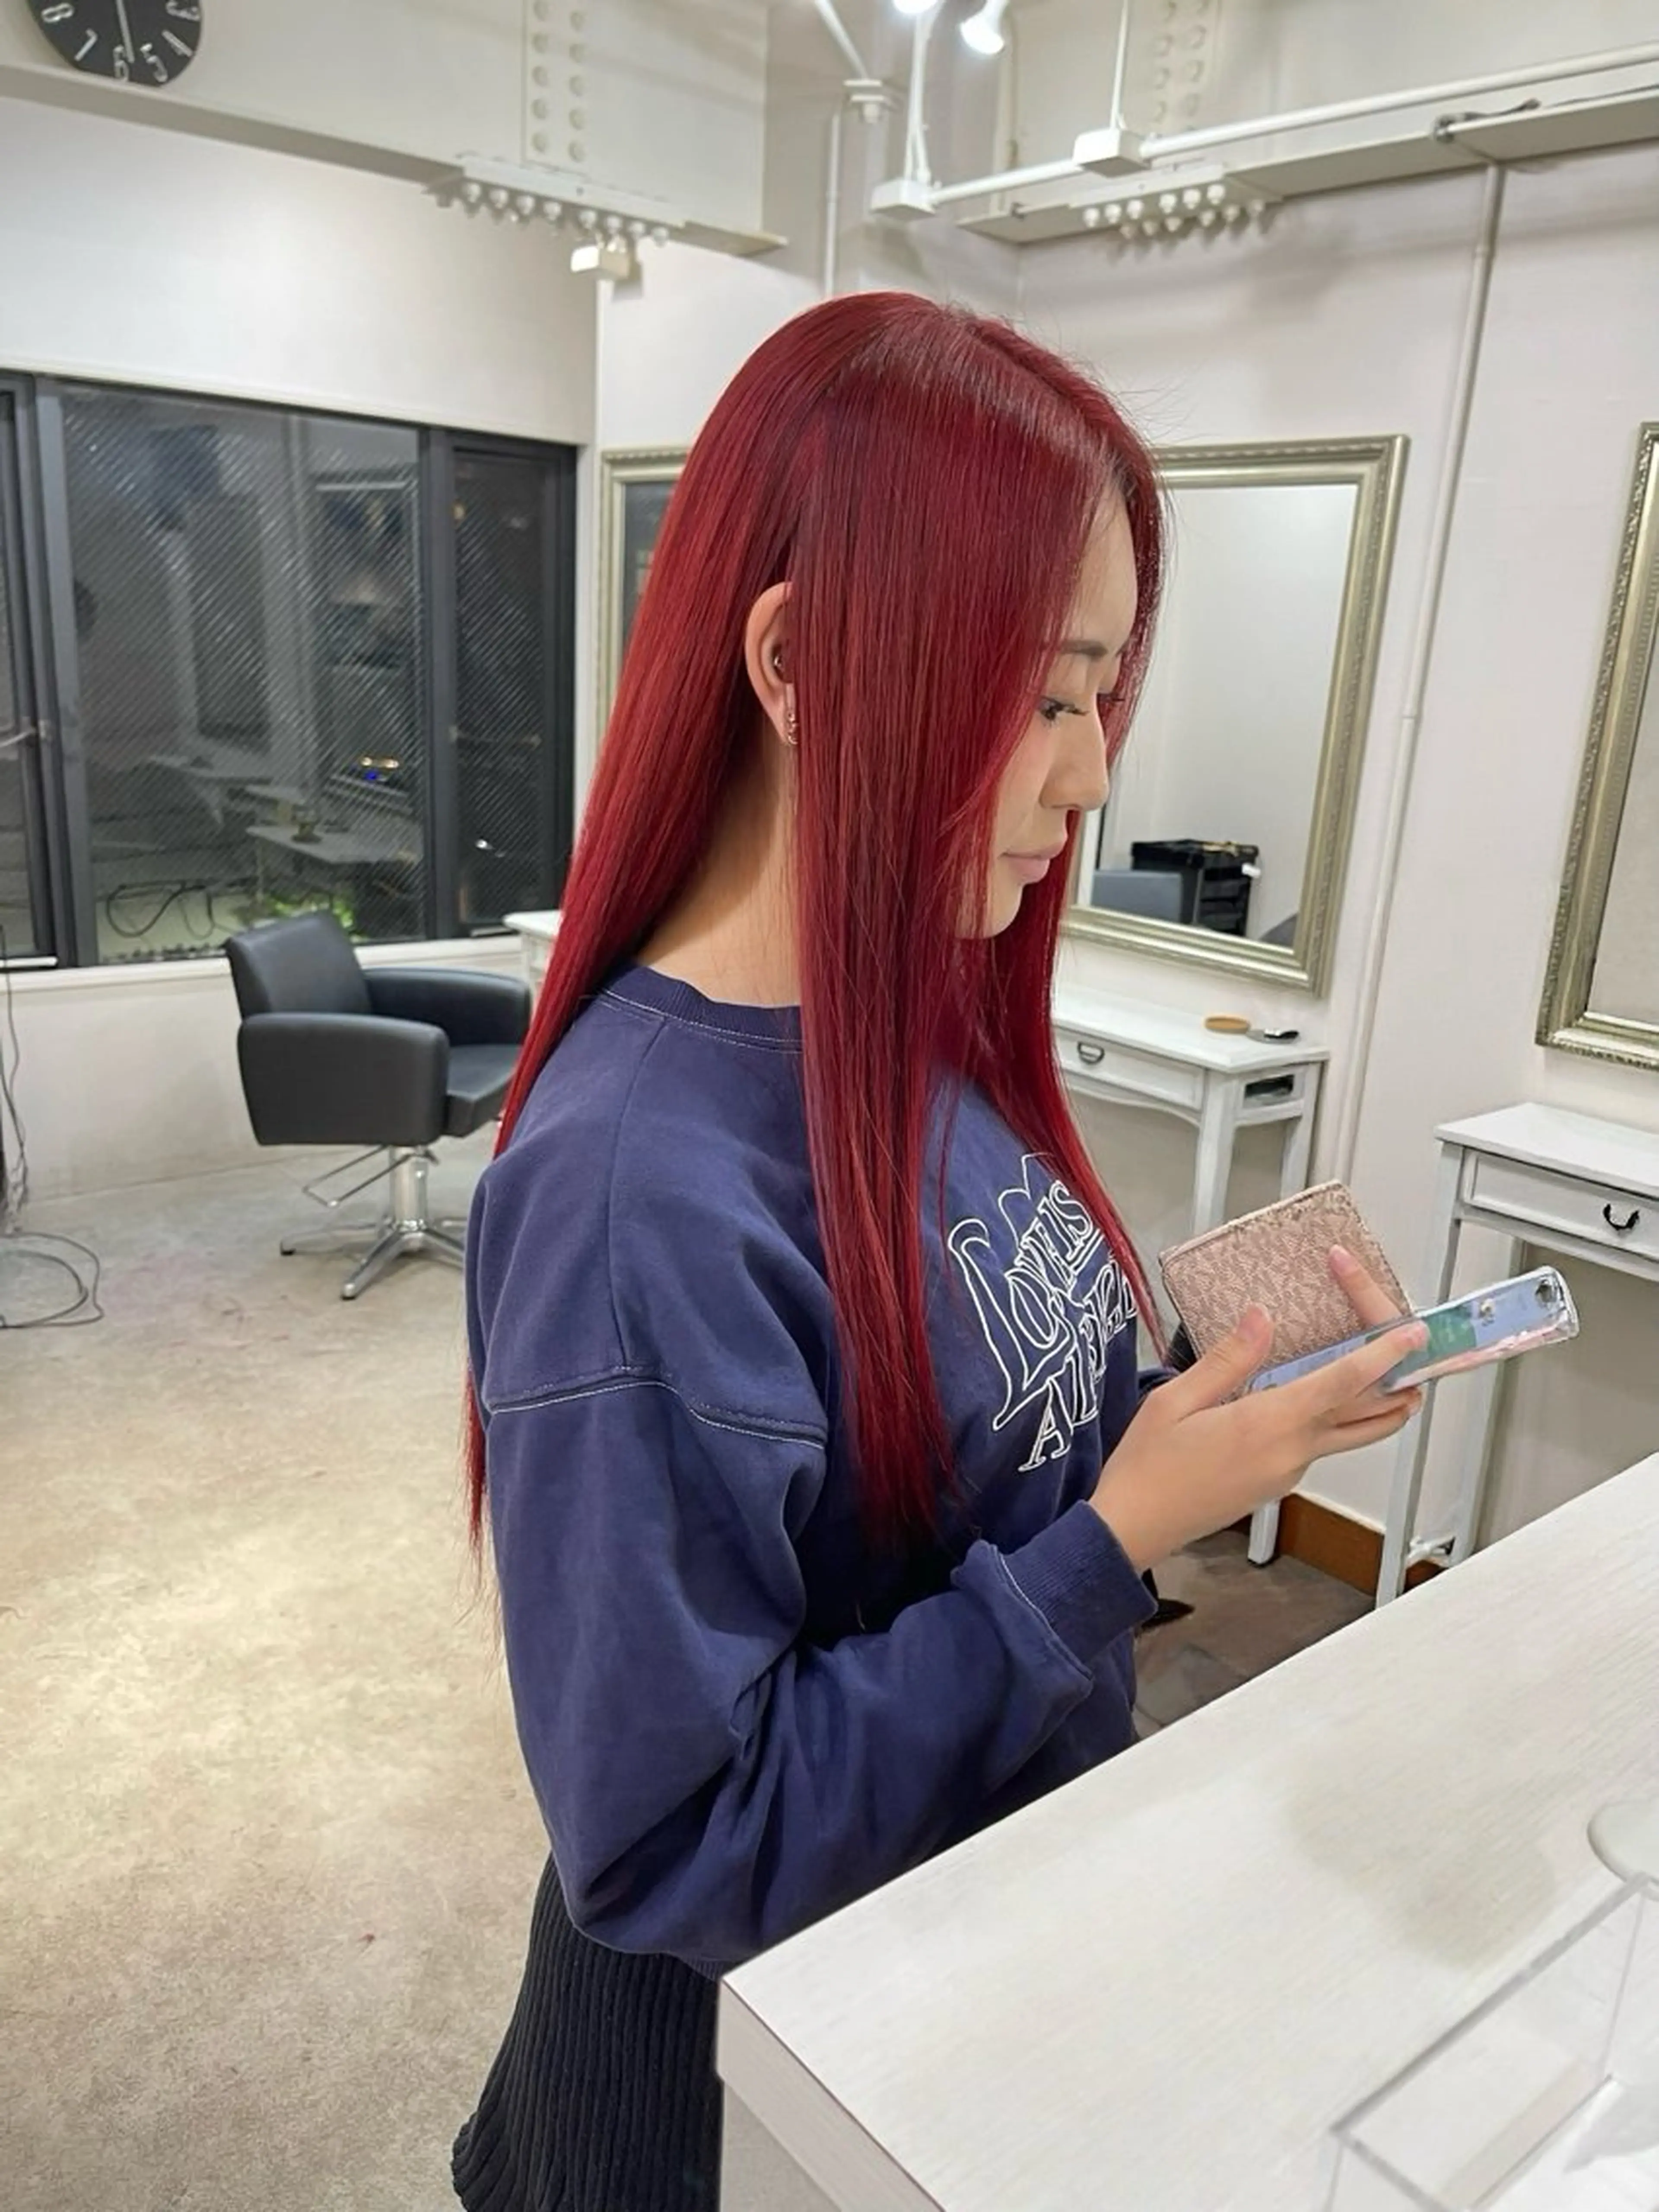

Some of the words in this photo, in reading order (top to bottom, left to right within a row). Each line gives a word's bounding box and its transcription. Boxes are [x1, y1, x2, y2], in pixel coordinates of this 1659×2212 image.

[41, 3, 73, 23] 8
[75, 29, 97, 61] 7
[140, 43, 168, 82] 5
[113, 44, 129, 82] 6
